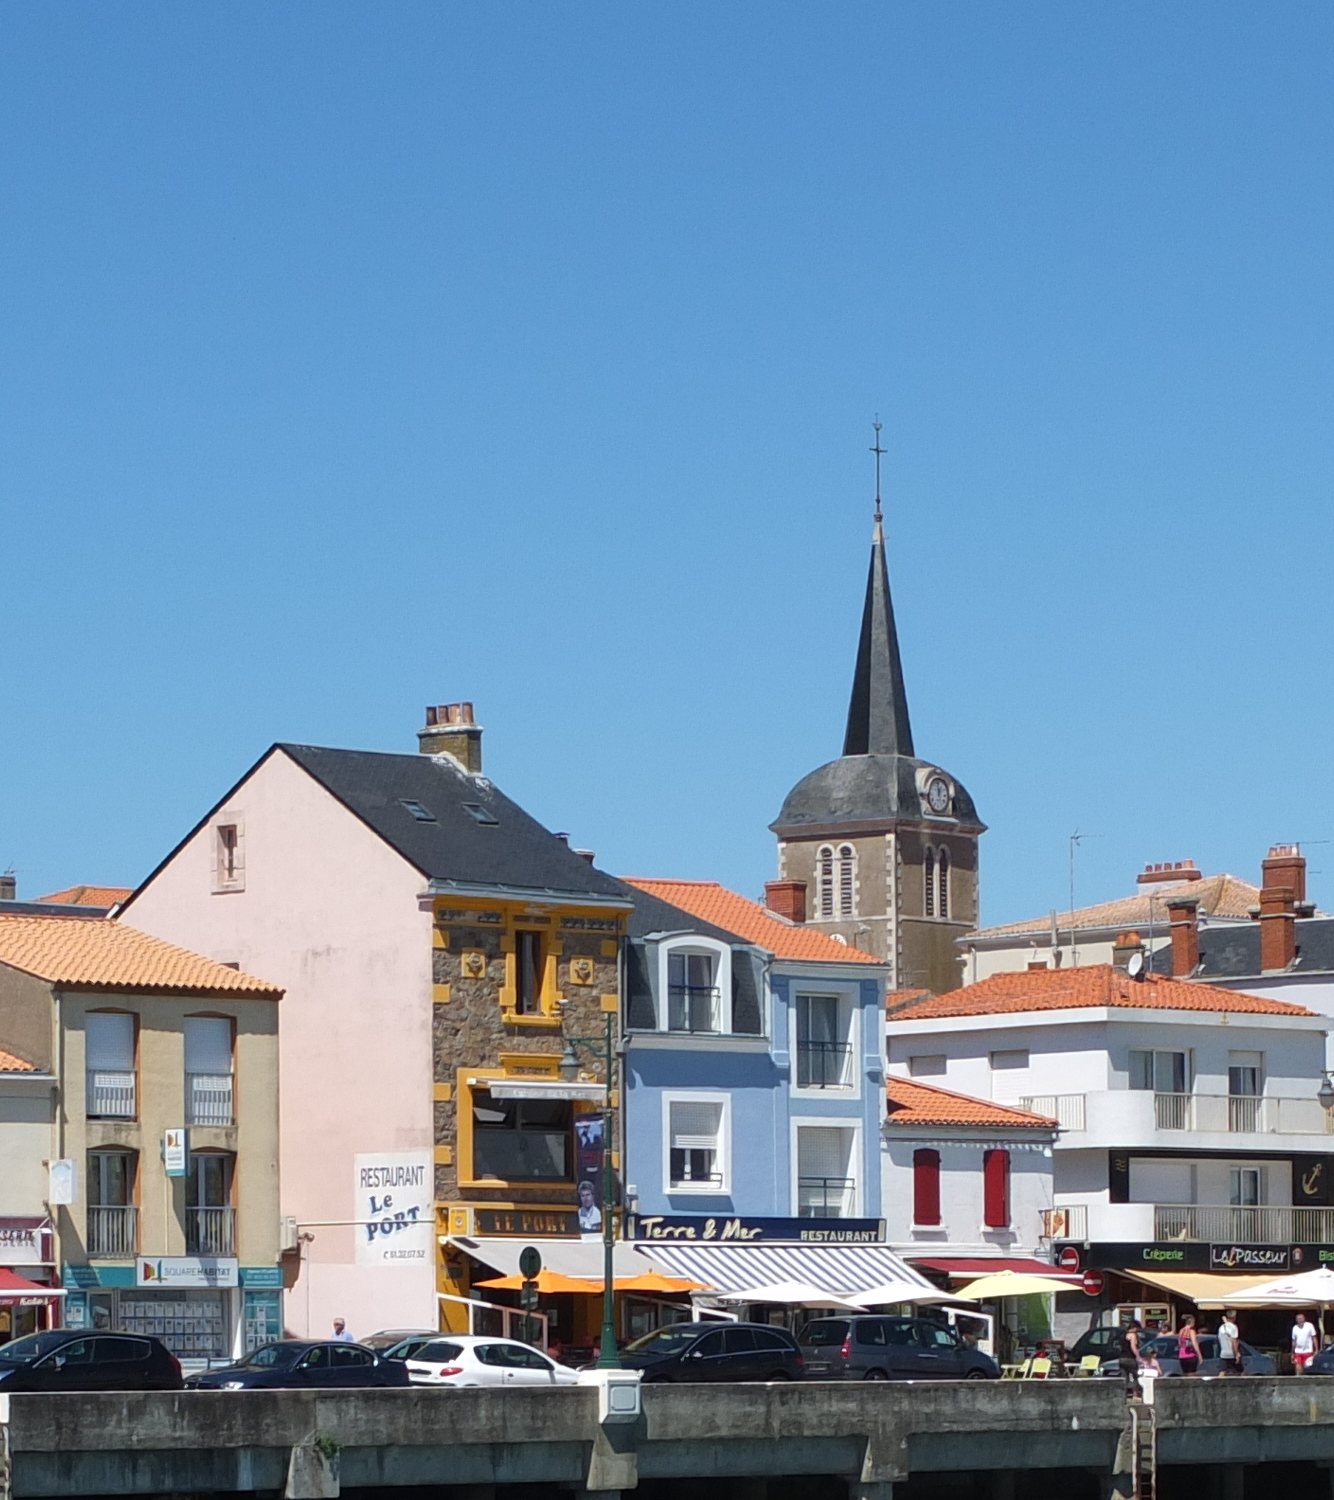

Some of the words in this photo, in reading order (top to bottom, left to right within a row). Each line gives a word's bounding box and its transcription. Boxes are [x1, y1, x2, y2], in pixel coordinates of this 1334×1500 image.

[360, 1165, 425, 1188] RESTAURANT
[369, 1194, 393, 1214] Le
[365, 1205, 420, 1242] PORT
[640, 1216, 697, 1239] Terre
[702, 1218, 717, 1240] &
[720, 1218, 763, 1240] Mer
[800, 1230, 877, 1242] RESTAURANT
[1235, 1249, 1287, 1265] Passeur
